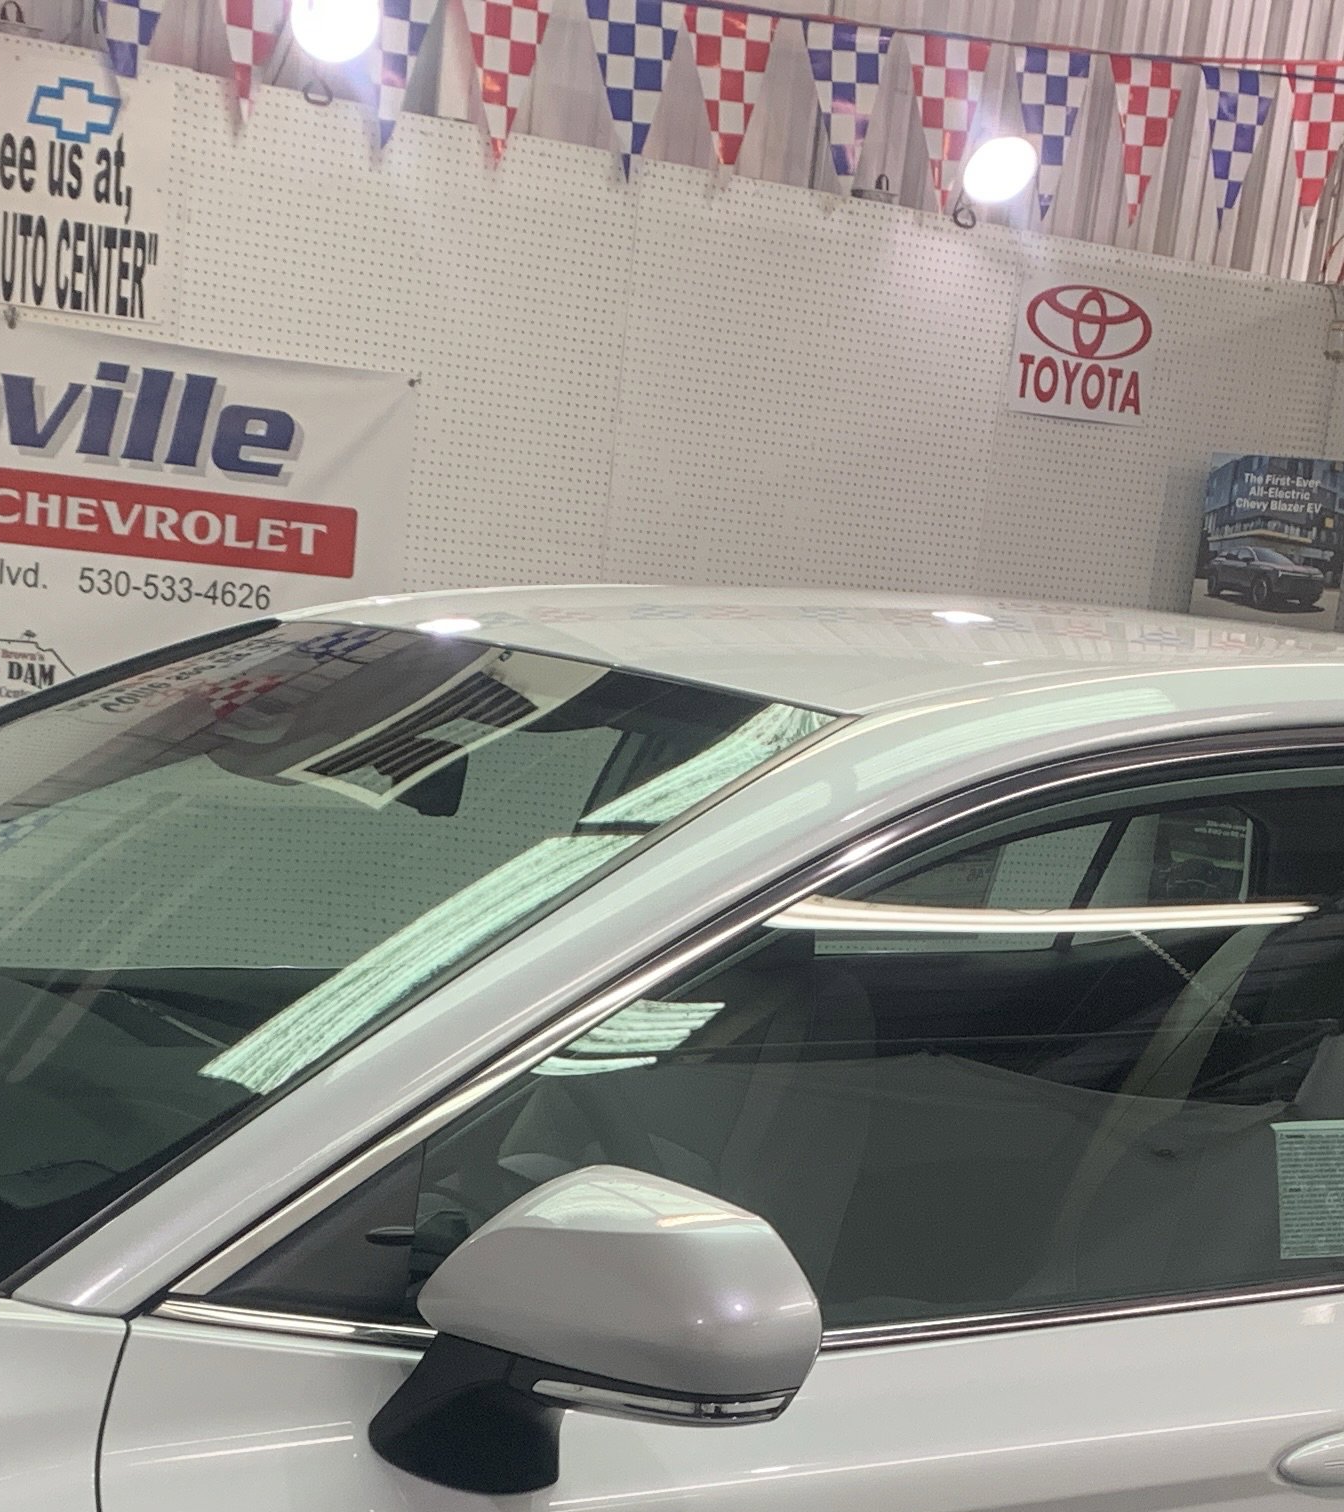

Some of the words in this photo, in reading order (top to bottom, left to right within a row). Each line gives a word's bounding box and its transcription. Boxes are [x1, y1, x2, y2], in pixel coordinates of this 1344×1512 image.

[48, 141, 83, 199] us
[94, 133, 132, 224] at,
[56, 218, 158, 319] CENTER"
[1019, 353, 1141, 415] TOYOTA
[1244, 472, 1263, 484] The
[1265, 474, 1321, 488] First-Ever
[1249, 487, 1311, 501] All-Electric
[1235, 497, 1269, 511] Chevy
[1270, 500, 1305, 513] Blazer
[1307, 502, 1322, 514] EV
[78, 566, 271, 611] 530-533-4626
[7, 661, 56, 689] DAM
